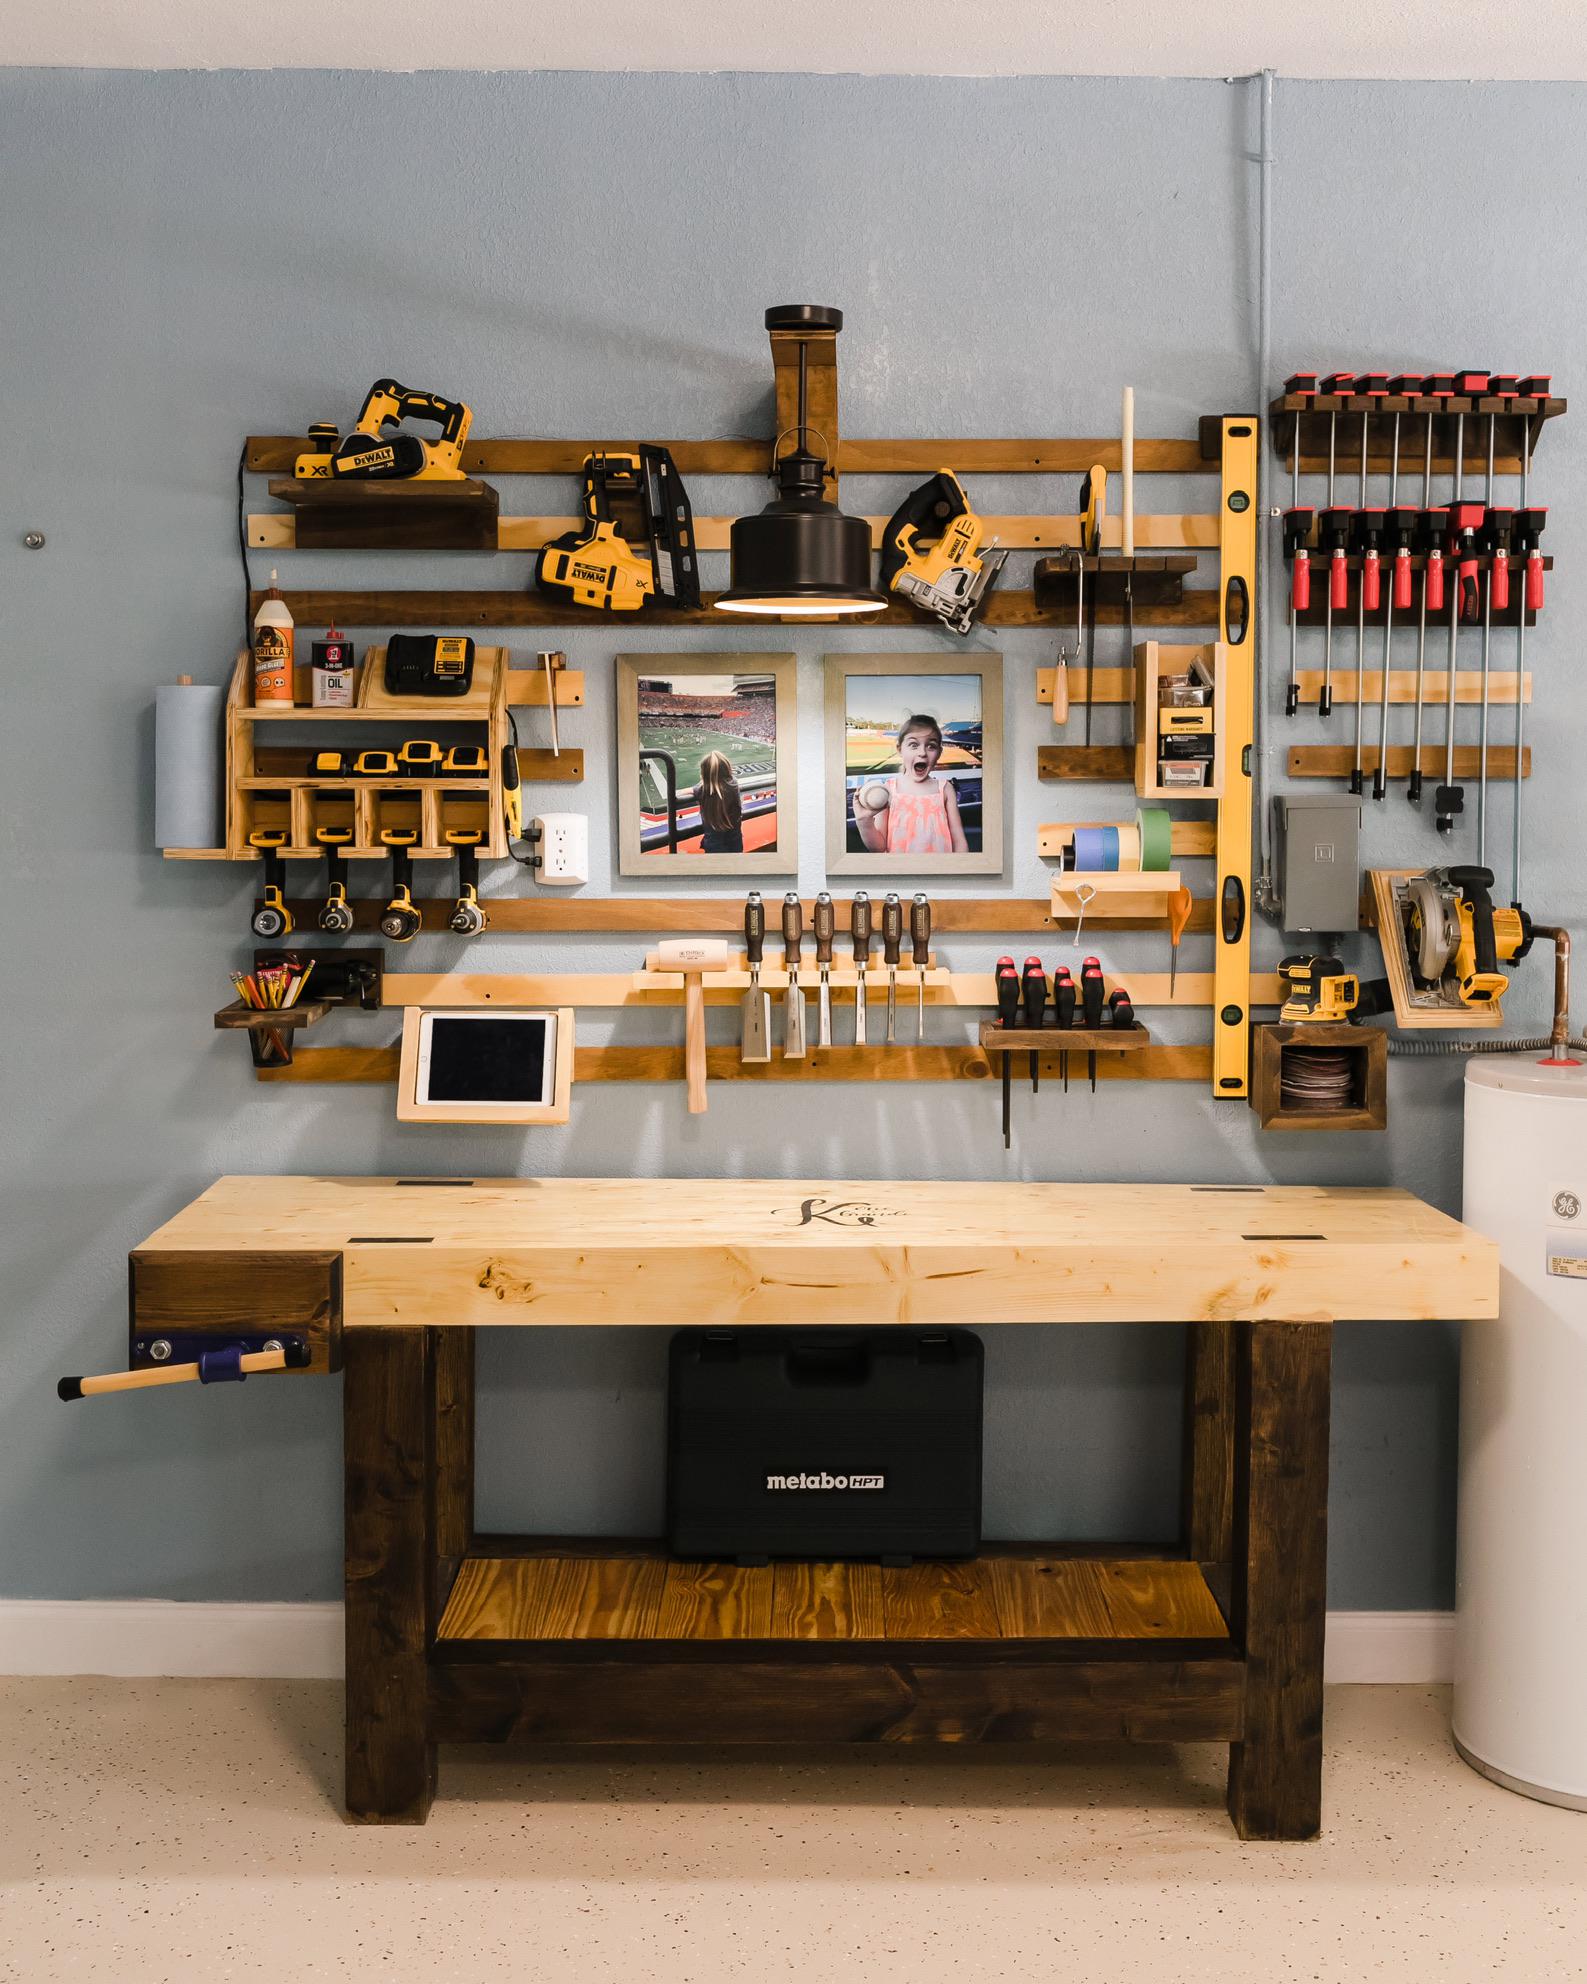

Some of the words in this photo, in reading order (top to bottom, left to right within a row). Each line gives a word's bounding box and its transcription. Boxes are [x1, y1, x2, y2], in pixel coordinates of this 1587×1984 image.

[310, 465, 329, 477] XR
[256, 648, 285, 657] ORILLA
[328, 679, 343, 689] OIL
[767, 1472, 848, 1489] metabo
[850, 1477, 883, 1488] HPT
